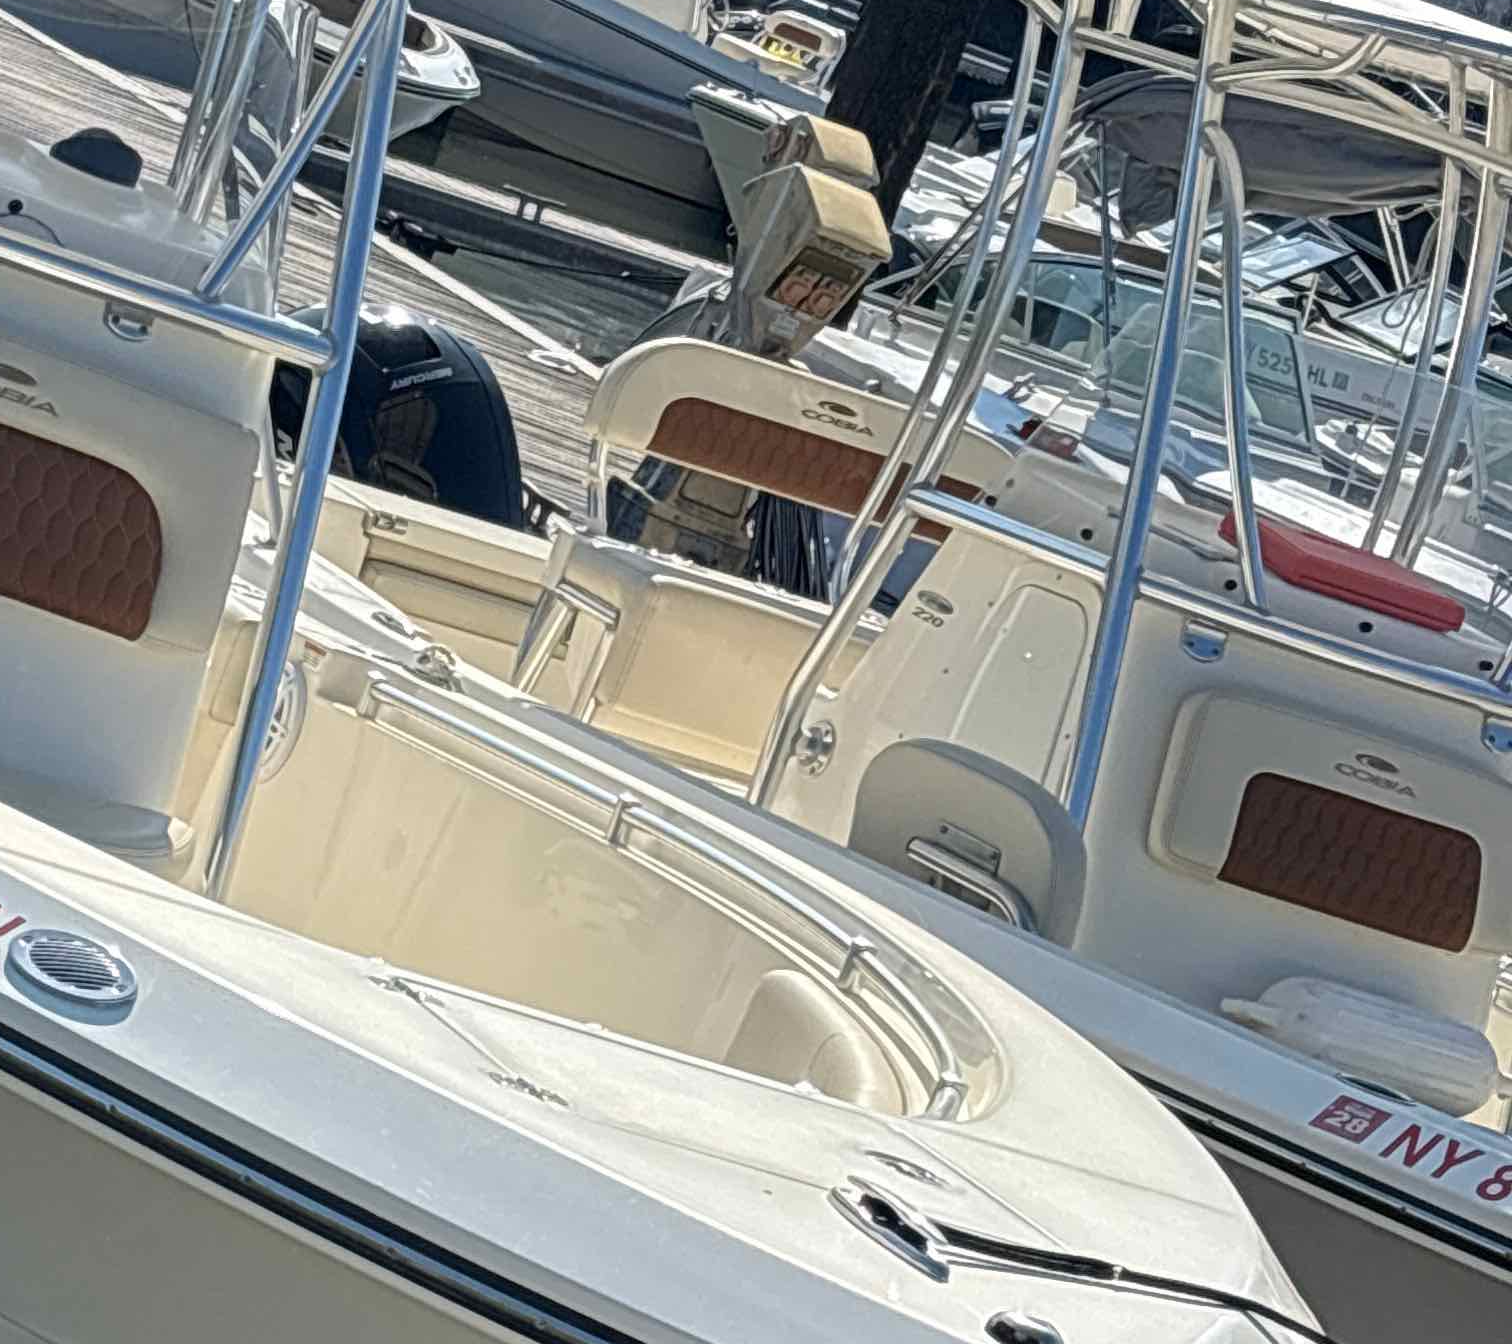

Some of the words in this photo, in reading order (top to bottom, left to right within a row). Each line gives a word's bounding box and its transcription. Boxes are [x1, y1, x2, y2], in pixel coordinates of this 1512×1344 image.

[801, 409, 874, 437] COBIA
[911, 605, 945, 629] 220
[1334, 762, 1416, 798] COBIA
[1324, 1108, 1371, 1135] 28
[1378, 1122, 1486, 1179] NY
